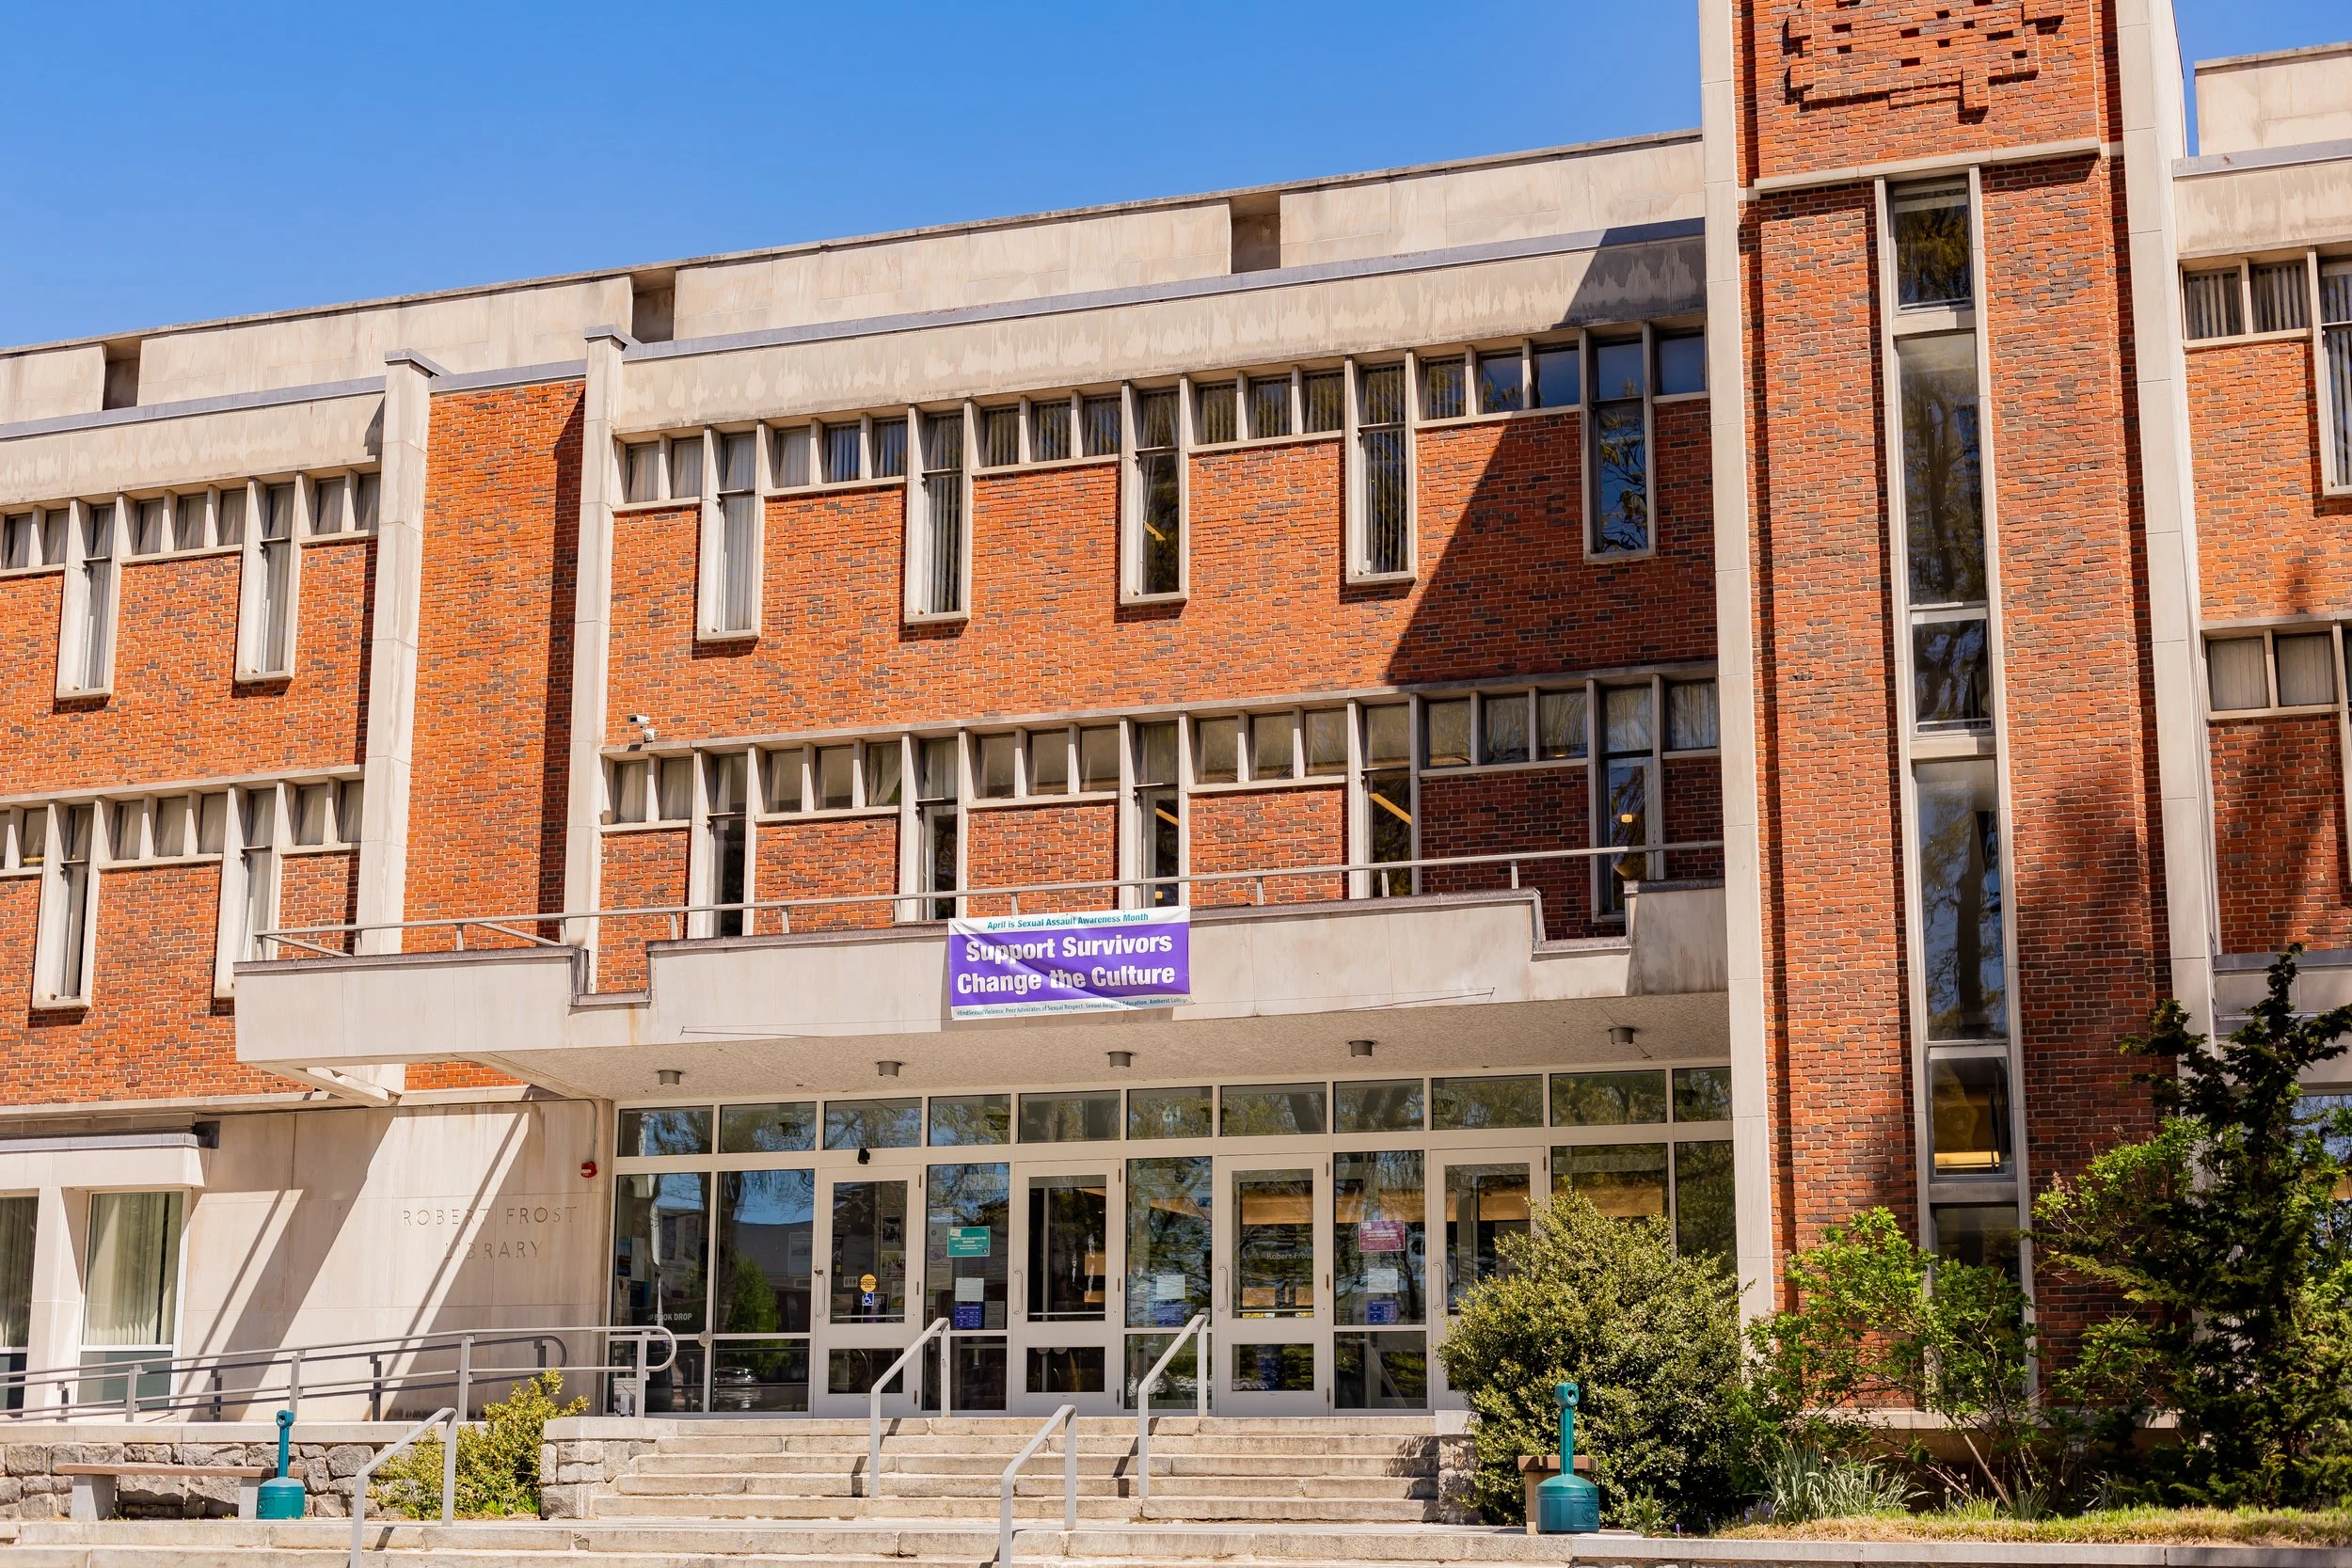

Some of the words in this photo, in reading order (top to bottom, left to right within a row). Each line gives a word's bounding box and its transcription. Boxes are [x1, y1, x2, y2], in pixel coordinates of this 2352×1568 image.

[987, 921, 1006, 930] April
[1008, 920, 1015, 928] is
[1017, 918, 1044, 928] Sexual
[1045, 916, 1076, 927] Assault
[1077, 914, 1120, 925] Awareness
[1122, 913, 1149, 922] Month
[965, 938, 1056, 965] Support
[1062, 934, 1173, 958] Survivors
[957, 973, 1042, 995] Change
[1049, 969, 1087, 989] the
[1091, 965, 1176, 987] Culture
[1085, 1000, 1103, 1009] Sexual
[1149, 994, 1170, 1005] Amherst
[402, 1207, 489, 1227] ROBERT
[505, 1206, 578, 1225] FROST
[444, 1241, 544, 1260] LIBRARY
[1266, 1251, 1293, 1260] Robert
[674, 1312, 692, 1321] DROP
